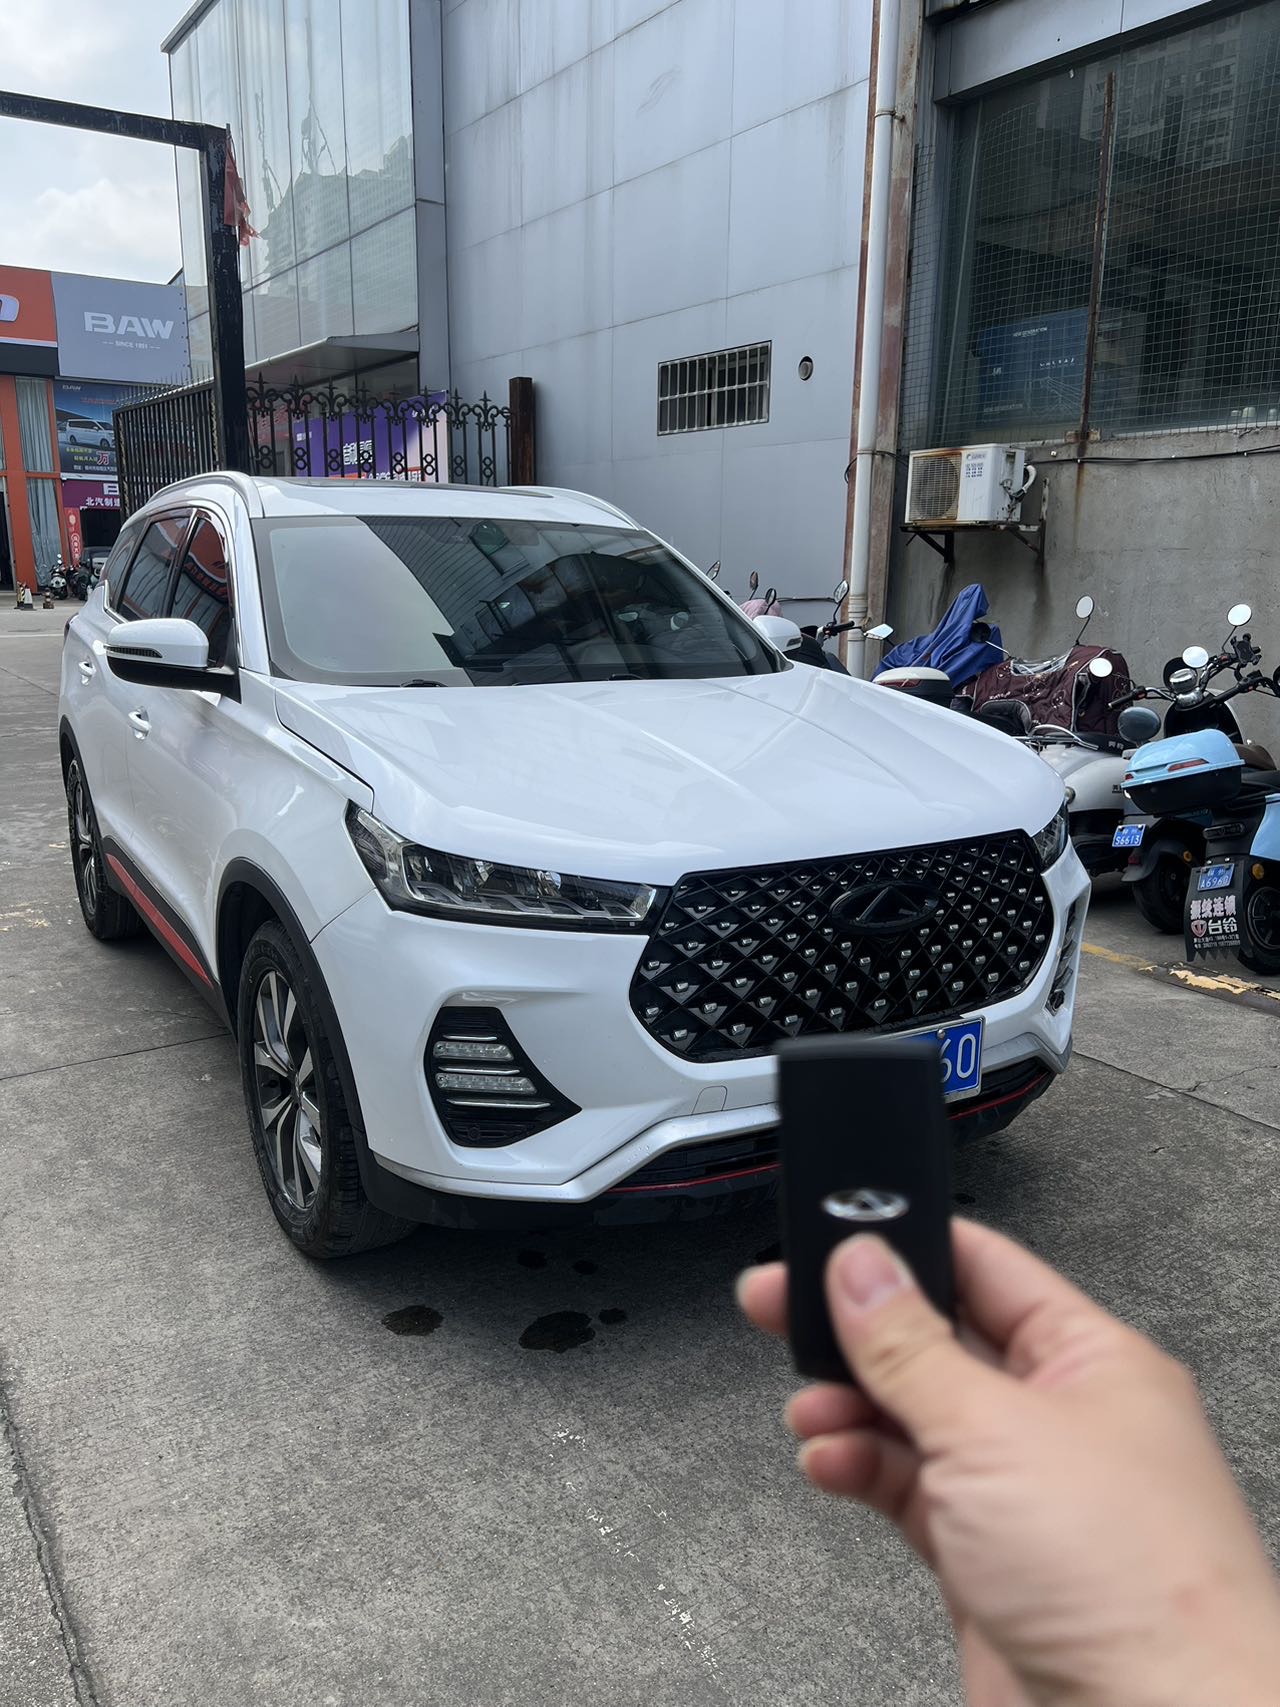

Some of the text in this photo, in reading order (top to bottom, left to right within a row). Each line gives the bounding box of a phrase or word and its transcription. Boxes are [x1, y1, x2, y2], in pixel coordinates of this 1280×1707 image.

[84, 311, 174, 340] BAW
[1115, 835, 1140, 845] S6613
[1208, 917, 1238, 934] 台铃
[940, 1033, 976, 1082] 60
